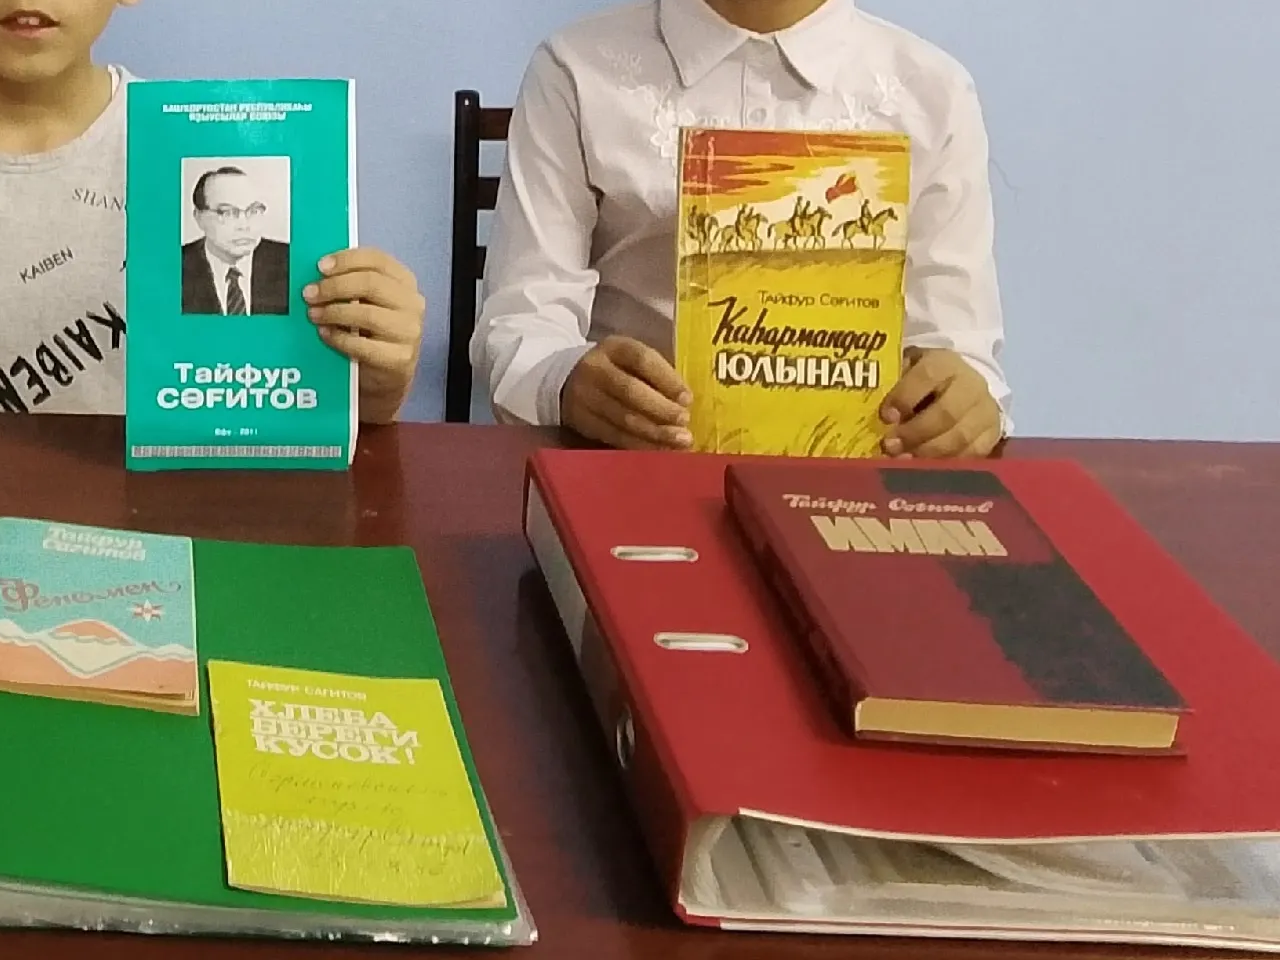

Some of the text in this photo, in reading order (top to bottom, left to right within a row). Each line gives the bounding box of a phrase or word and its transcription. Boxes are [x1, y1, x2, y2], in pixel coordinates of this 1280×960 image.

[19, 245, 74, 285] KAIBEN
[173, 362, 301, 388] Тайфур
[717, 351, 879, 389] ЮЛЫНАН
[809, 514, 1009, 557] ИМАН
[247, 697, 398, 730] ХЛЕБА
[250, 715, 423, 748] БЕРЕГИ
[251, 733, 416, 766] КУСОК!
